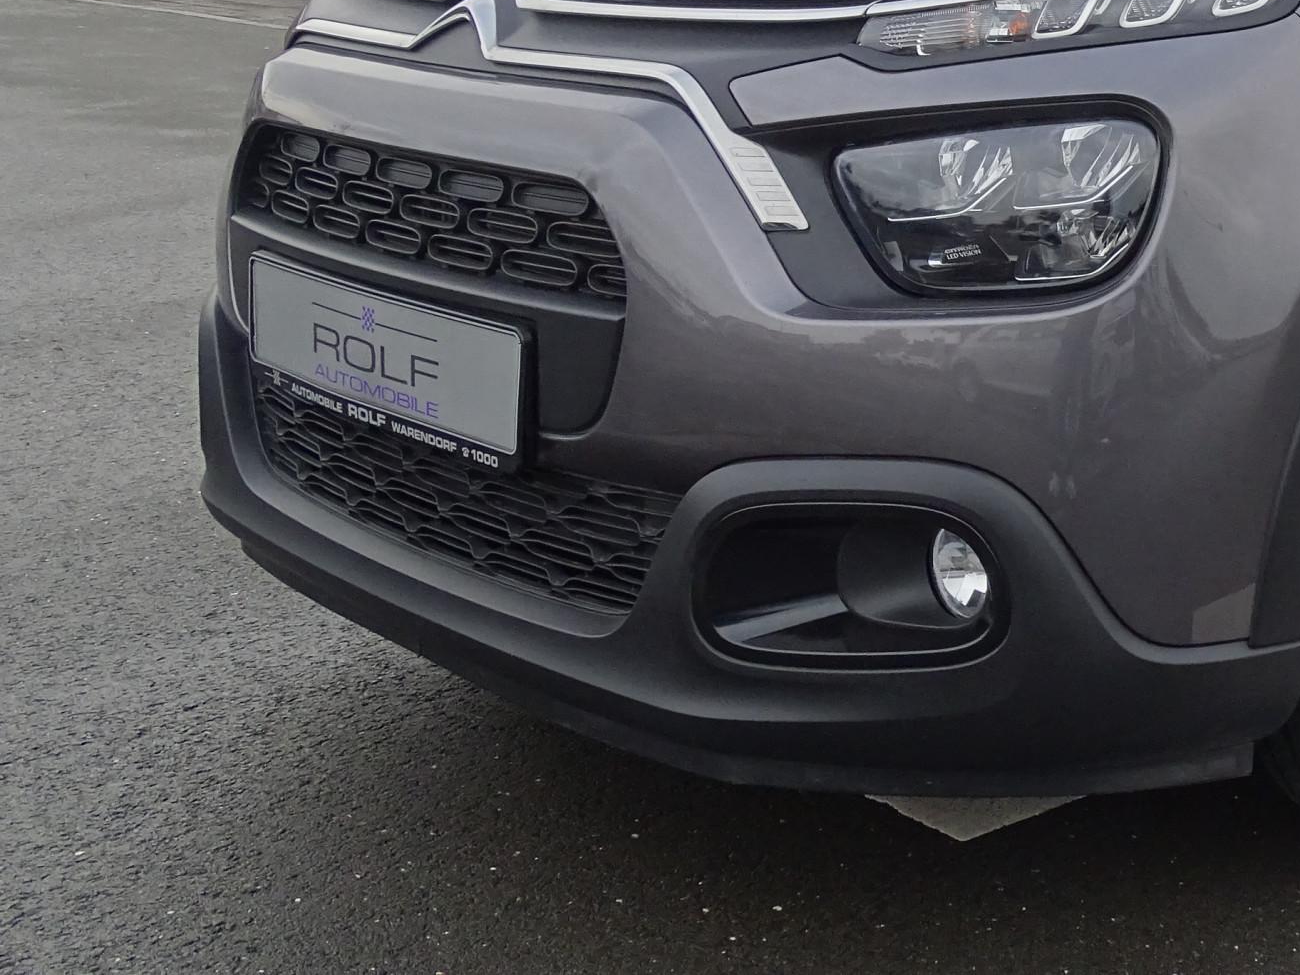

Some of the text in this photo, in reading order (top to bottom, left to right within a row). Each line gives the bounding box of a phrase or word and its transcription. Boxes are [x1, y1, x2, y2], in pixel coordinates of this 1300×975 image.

[959, 248, 982, 258] VISION
[313, 322, 439, 387] ROLF
[291, 382, 343, 413] AUTOMOBILE
[347, 403, 386, 427] ROLF
[391, 421, 457, 453] WARENDORF
[314, 363, 439, 419] AUTOMOBILE
